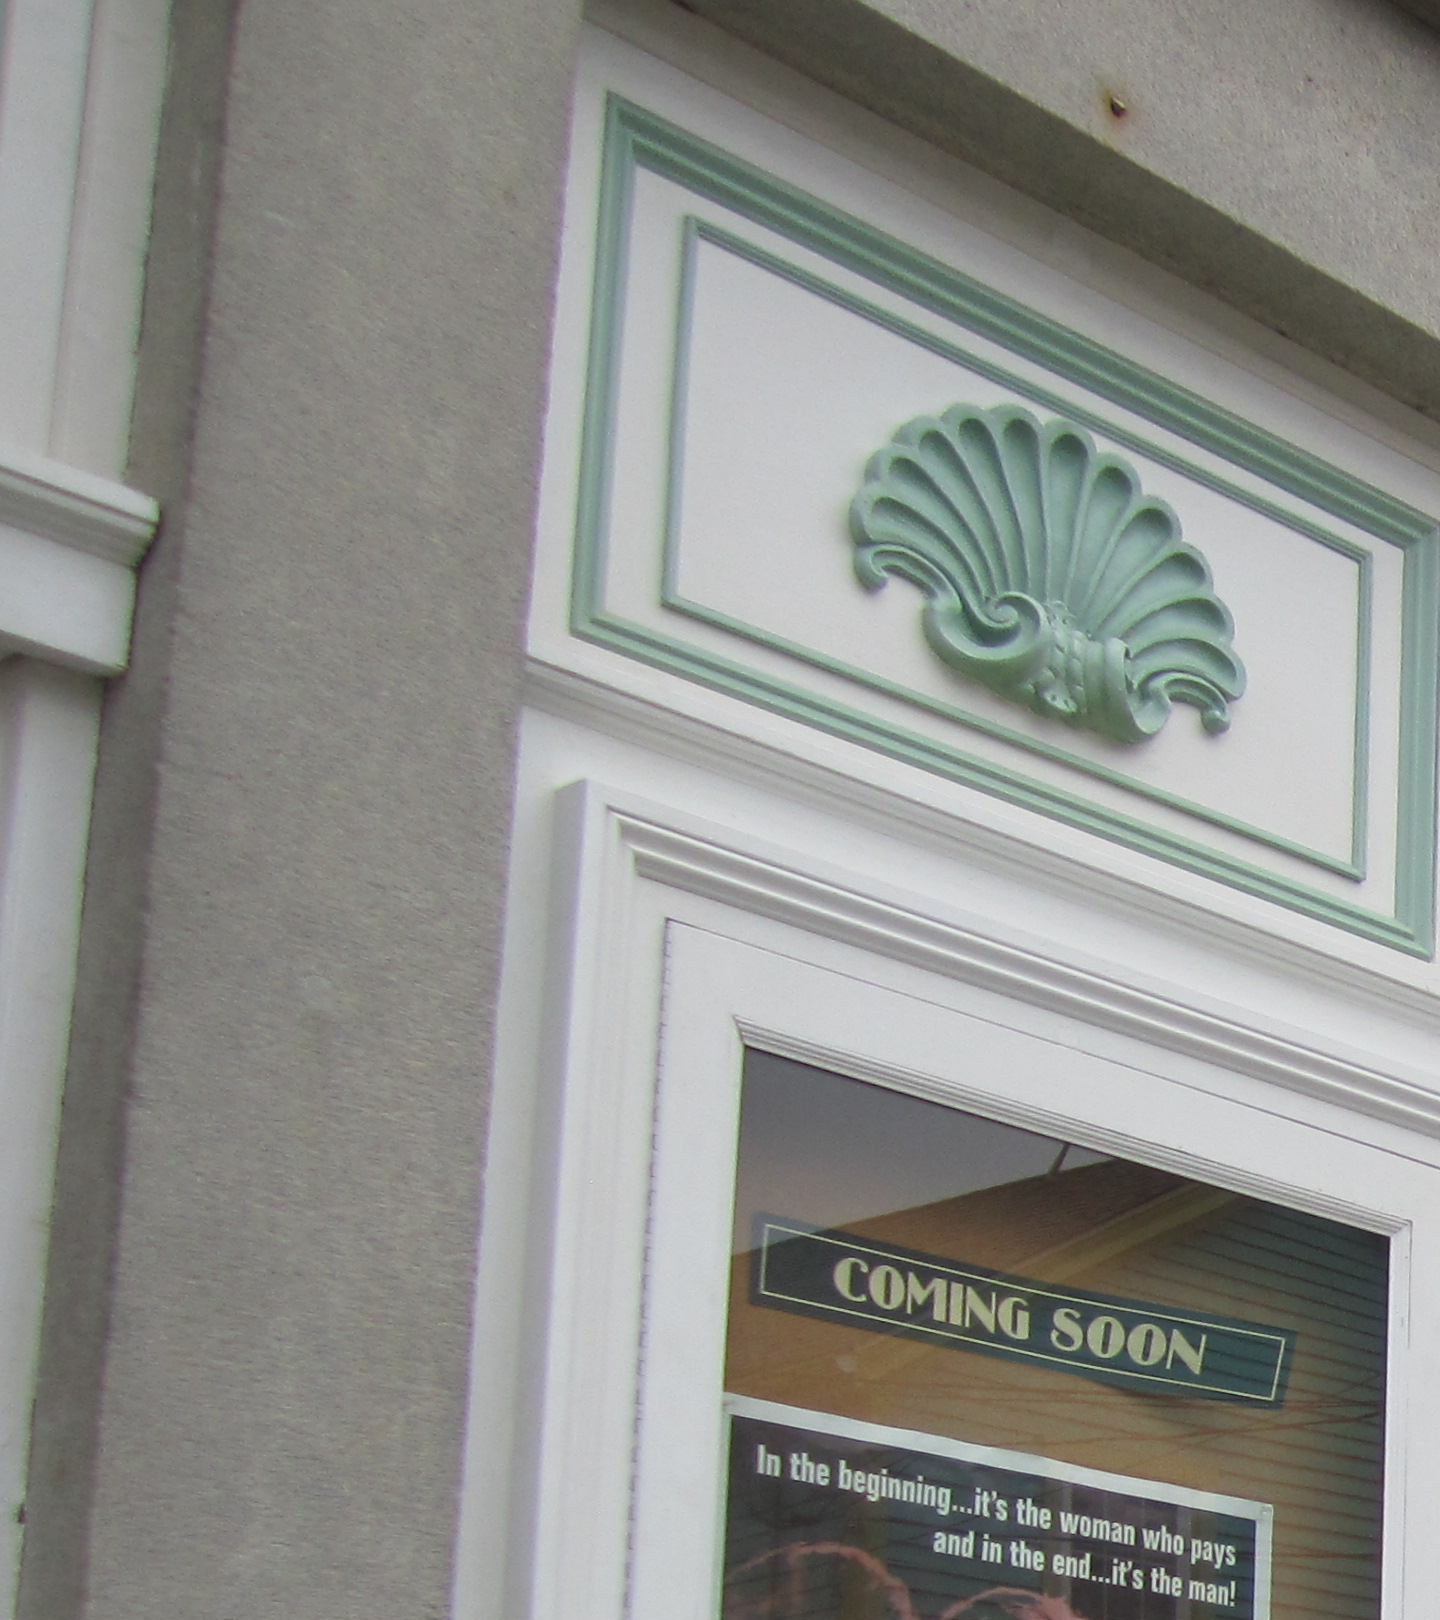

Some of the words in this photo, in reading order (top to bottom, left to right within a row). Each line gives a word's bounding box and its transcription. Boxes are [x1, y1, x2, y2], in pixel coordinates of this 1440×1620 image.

[834, 1258, 1030, 1341] COMING
[1050, 1308, 1207, 1375] SOON
[757, 1444, 781, 1478] In
[790, 1450, 830, 1487] the
[1017, 1498, 1051, 1531] the
[1060, 1511, 1135, 1549] woman
[1142, 1517, 1184, 1554] who
[1191, 1538, 1236, 1567] pays
[934, 1531, 973, 1560] and
[982, 1535, 1002, 1564] in
[1010, 1541, 1044, 1572] the
[1151, 1566, 1182, 1597] the
[1188, 1577, 1236, 1607] man!
